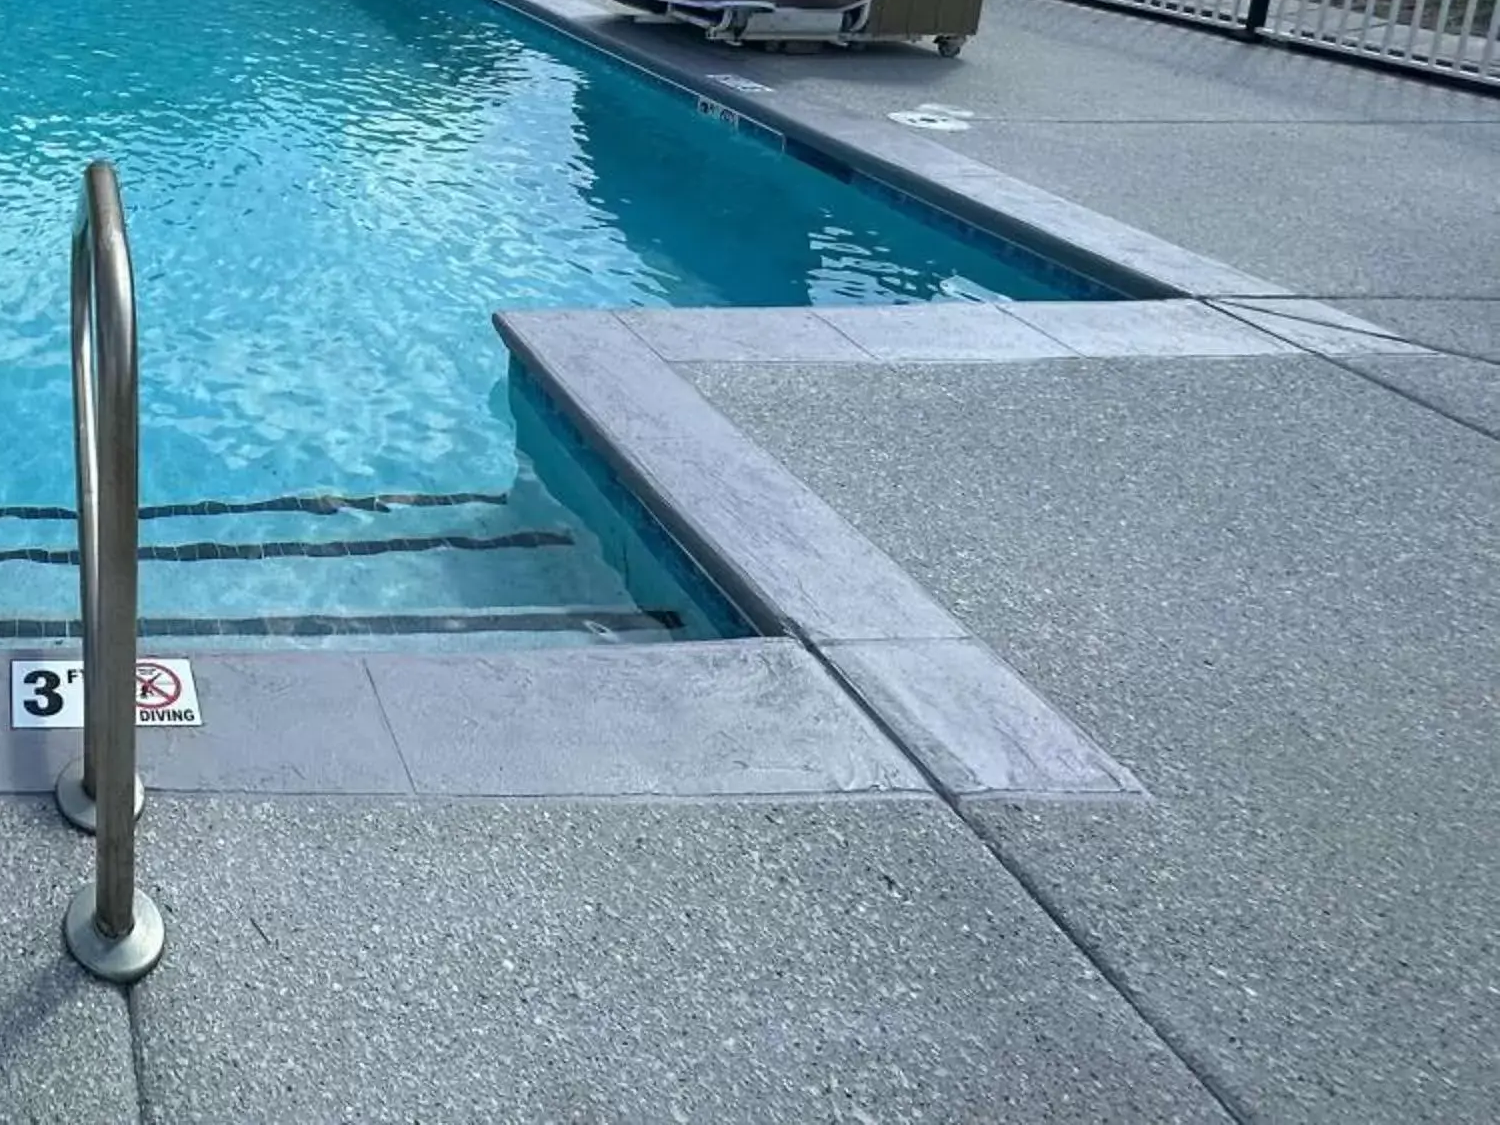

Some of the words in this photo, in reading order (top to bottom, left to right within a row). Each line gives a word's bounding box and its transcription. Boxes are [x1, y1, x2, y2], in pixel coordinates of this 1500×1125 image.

[23, 669, 64, 717] 3
[67, 669, 84, 684] F
[139, 708, 195, 722] DIVING
